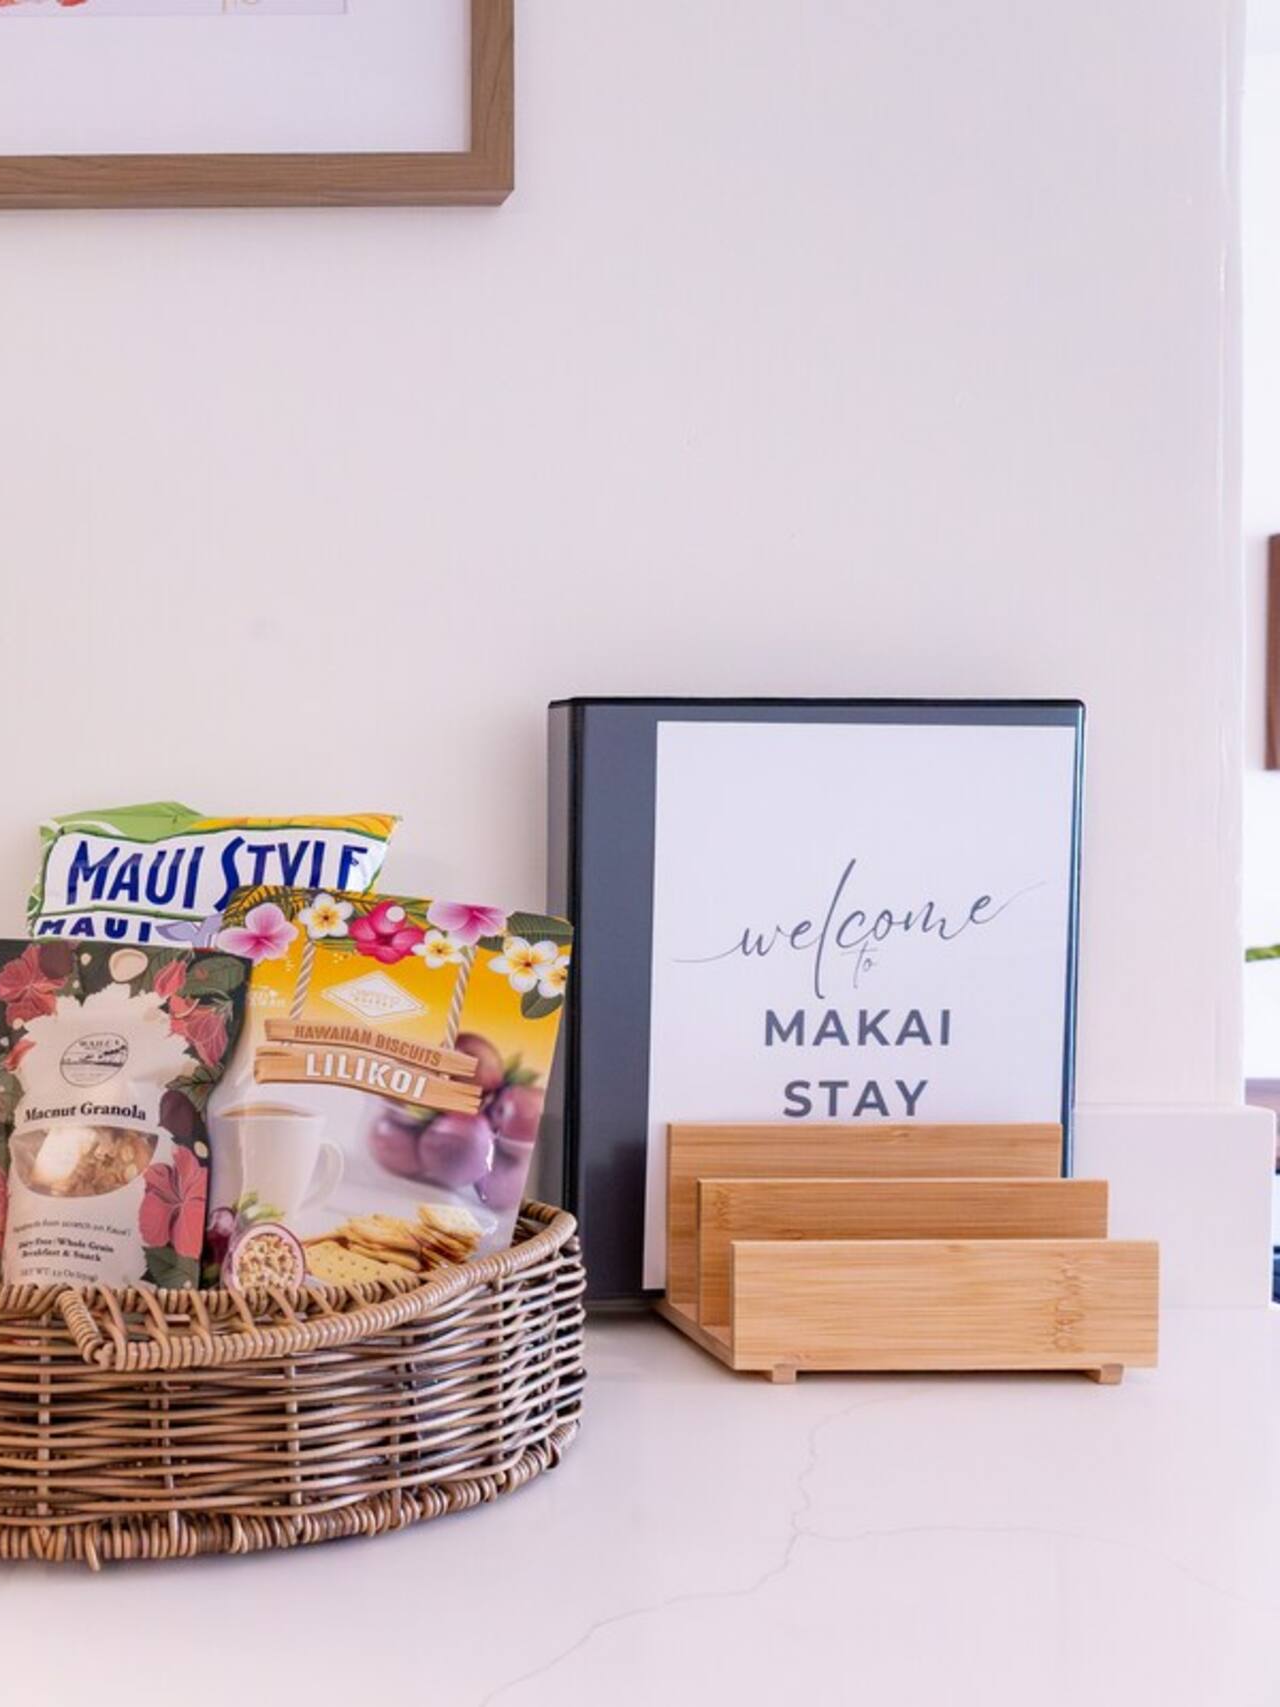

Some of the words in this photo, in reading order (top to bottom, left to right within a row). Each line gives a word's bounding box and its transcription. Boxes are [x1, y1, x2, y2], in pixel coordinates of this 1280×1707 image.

[66, 840, 205, 909] MAUI
[37, 917, 152, 943] MAUI
[672, 858, 1047, 999] welcome
[841, 941, 877, 989] to
[294, 1025, 371, 1045] HAWAIIAN
[375, 1032, 442, 1067] BISCUITS
[764, 1009, 951, 1047] MAKAI
[305, 1052, 428, 1099] LILIKOI
[24, 1106, 76, 1121] Macnut
[80, 1101, 146, 1121] Granola
[782, 1080, 929, 1118] STAY
